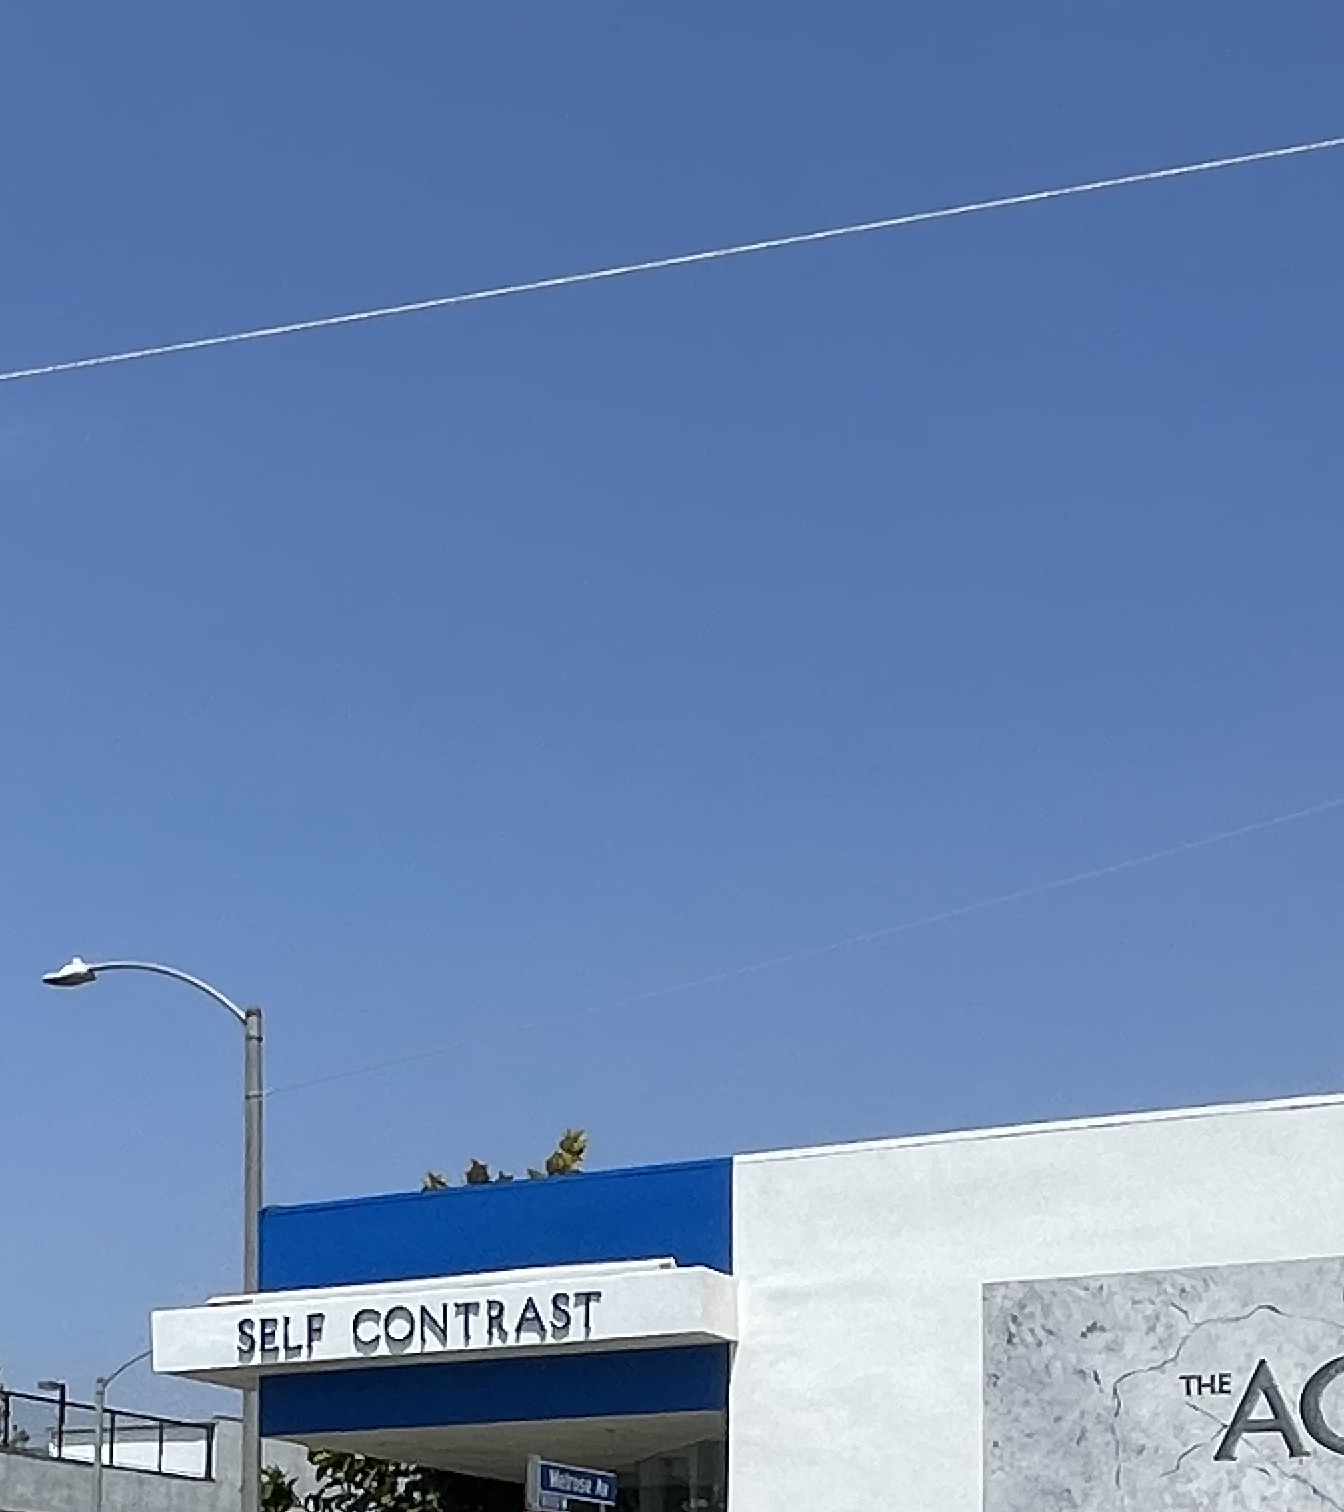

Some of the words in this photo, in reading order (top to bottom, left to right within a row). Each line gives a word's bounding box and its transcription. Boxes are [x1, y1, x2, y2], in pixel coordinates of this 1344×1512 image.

[237, 1312, 325, 1363] SELF
[352, 1290, 602, 1355] CONTRAST
[1178, 1372, 1233, 1397] THE
